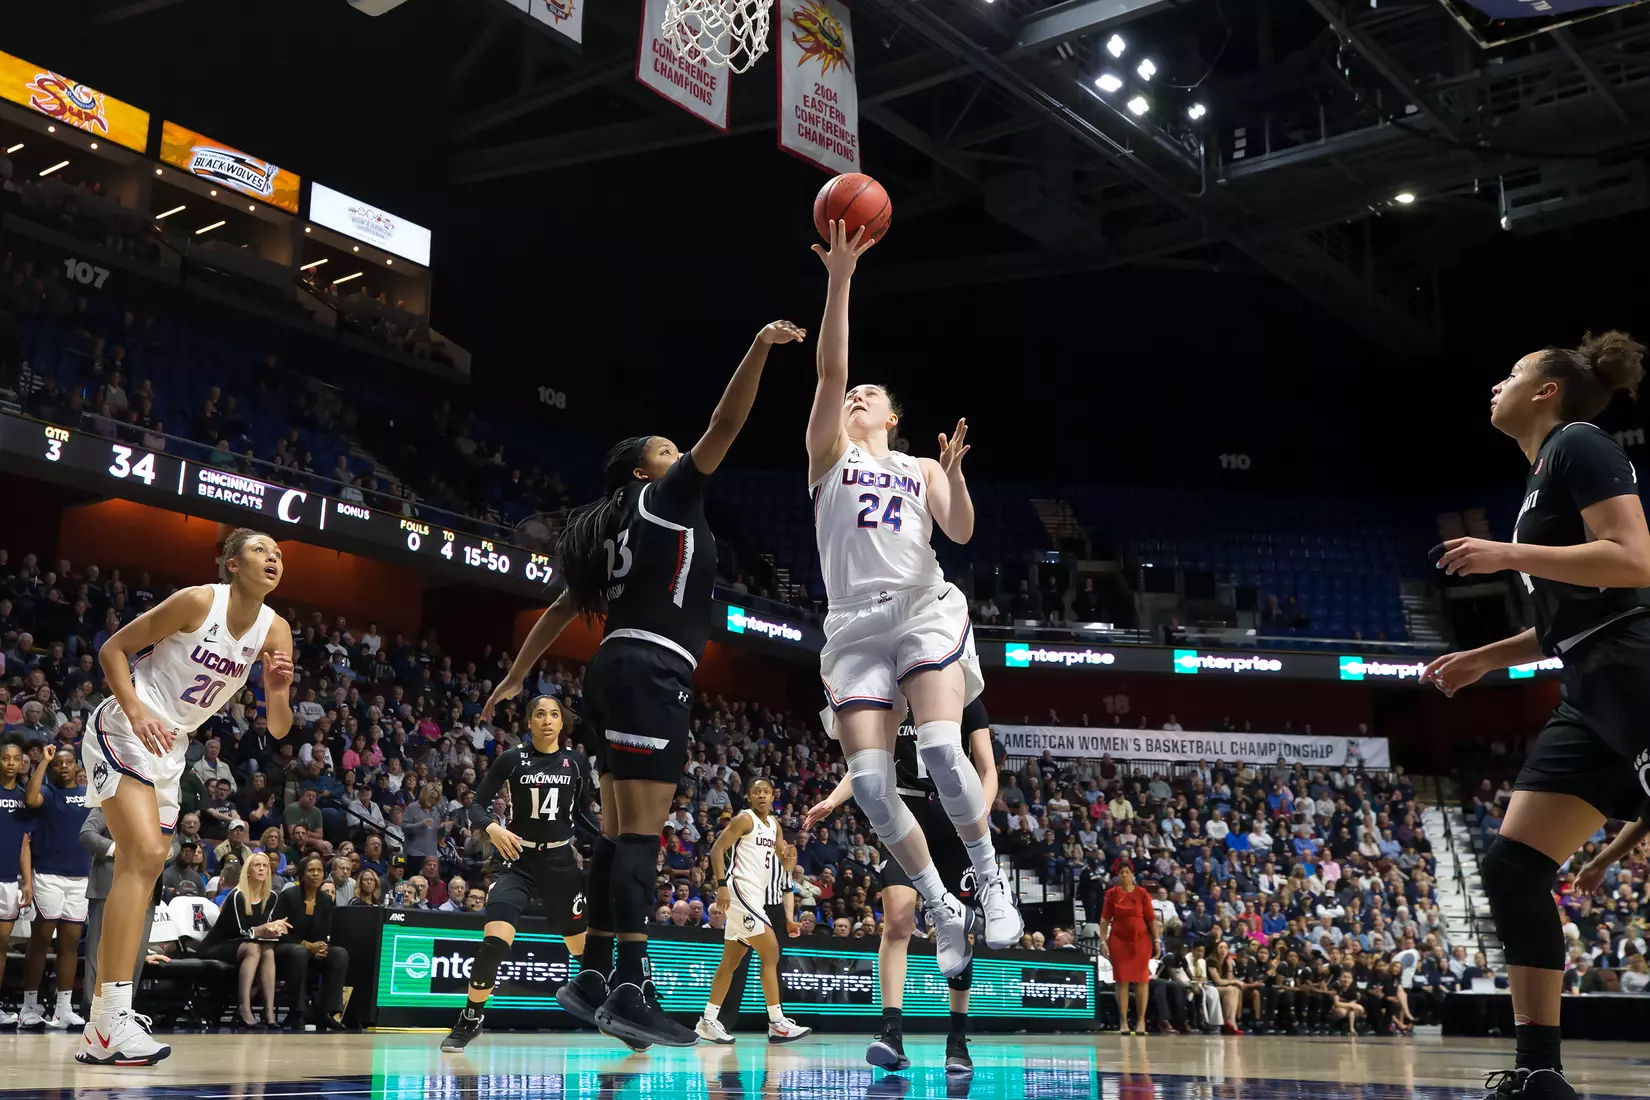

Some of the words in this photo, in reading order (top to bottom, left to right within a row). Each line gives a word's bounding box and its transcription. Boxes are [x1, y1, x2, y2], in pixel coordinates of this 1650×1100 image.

[652, 38, 717, 91] CONFERENCE
[653, 57, 713, 106] CHAMPIONS
[814, 82, 838, 104] 2004
[803, 94, 846, 127] EASTERN
[795, 104, 856, 147] CONFERENCE
[797, 123, 854, 163] CHAMPIONS
[64, 258, 110, 289] 107
[538, 386, 567, 409] 108
[45, 426, 70, 442] QTR
[45, 439, 62, 461] 3
[108, 444, 156, 485] 34
[1218, 454, 1251, 470] 110
[198, 469, 265, 496] CINCINNATI
[842, 468, 921, 498] UCONN
[198, 484, 263, 510] BEARCATS
[337, 502, 370, 520] BONUS
[857, 493, 904, 532] 24
[400, 519, 430, 536] FOULS
[442, 530, 455, 542] TO
[407, 532, 421, 551] 0
[440, 542, 453, 560] 4
[481, 540, 494, 552] FG
[463, 546, 510, 574] 15-50
[530, 553, 549, 566] 3-PT
[525, 562, 553, 584] 0-7
[728, 612, 802, 642] enterprise
[190, 645, 247, 679] UCONN
[1005, 648, 1115, 667] enterprise
[1174, 655, 1282, 673] enterprise
[1340, 661, 1429, 679] enterpri
[180, 674, 226, 709] 20
[1003, 733, 1075, 750] AMERICAN
[1078, 736, 1142, 753] WOMEN'S
[1145, 739, 1227, 756] BASKETBALL
[1230, 741, 1334, 759] CHAMPIONSHIP
[520, 772, 571, 786] CINCINNATI
[529, 787, 560, 820] 14
[756, 837, 776, 848] UCON
[764, 850, 771, 870] 5
[389, 913, 406, 922] ANC
[393, 951, 568, 989] enteprise
[781, 968, 873, 997] nterprise
